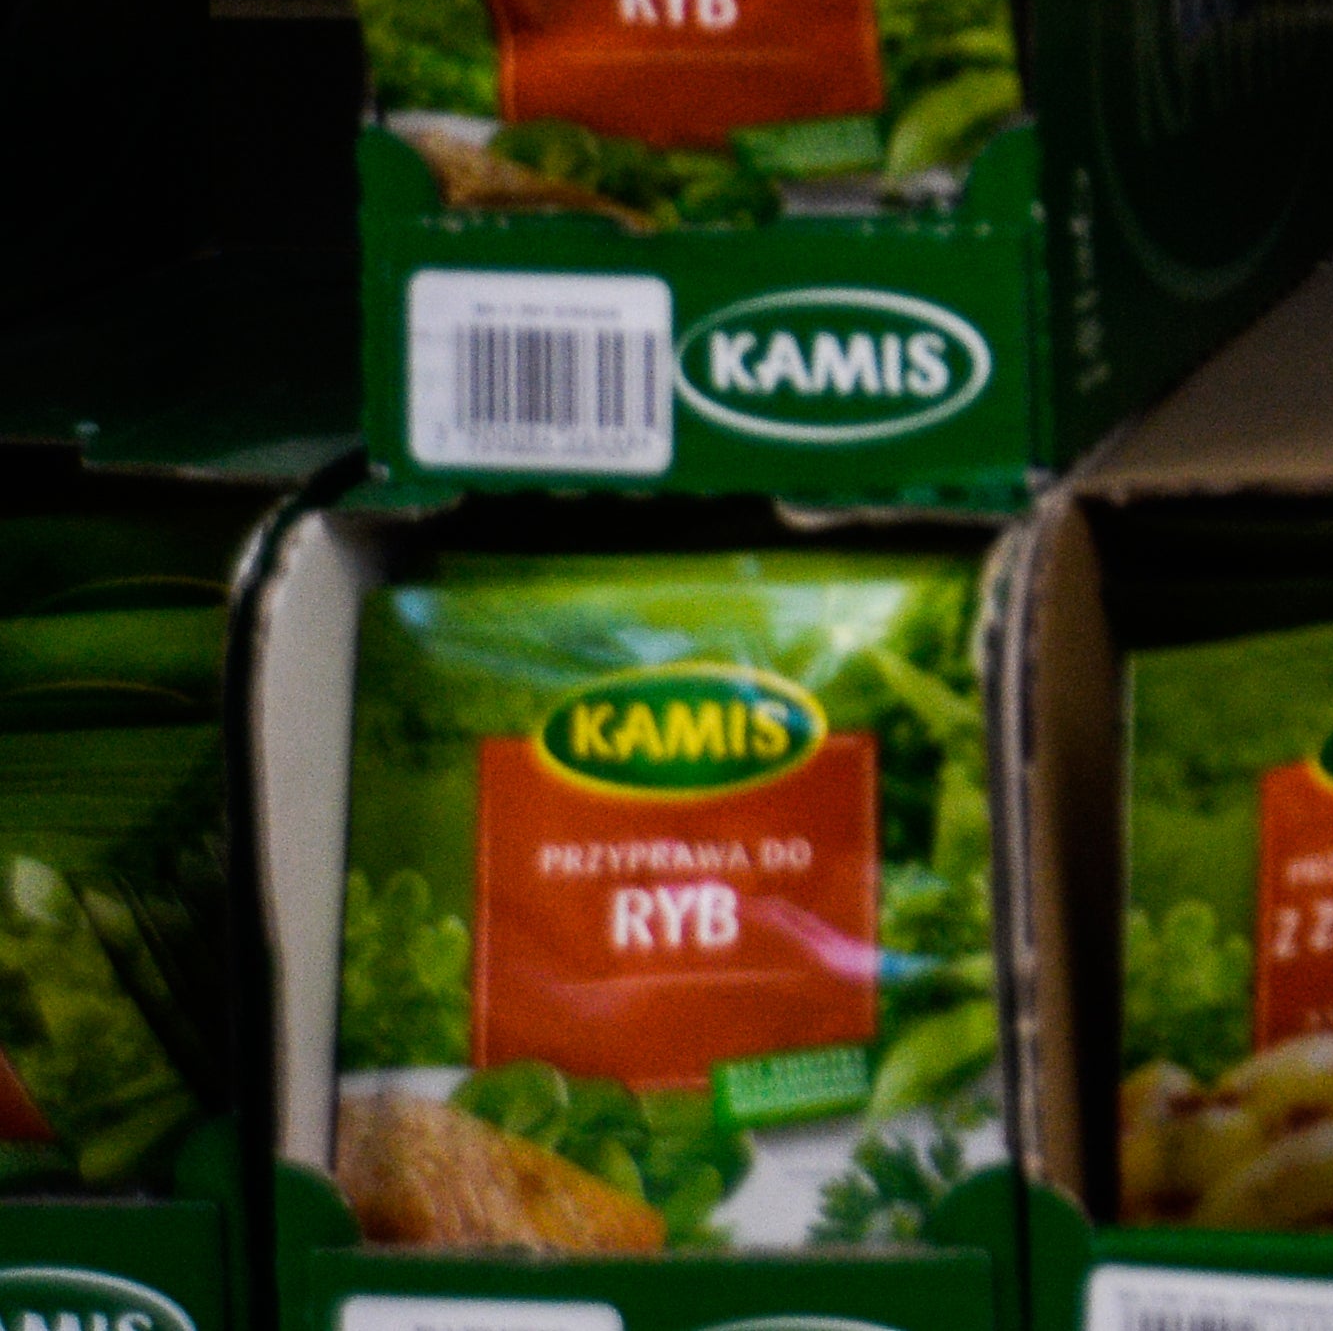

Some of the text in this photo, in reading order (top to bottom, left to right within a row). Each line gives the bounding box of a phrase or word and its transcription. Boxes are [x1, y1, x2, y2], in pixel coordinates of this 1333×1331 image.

[709, 329, 951, 399] KAMIS
[571, 700, 792, 761] KAMIS
[538, 835, 813, 877] PRZYPRAWA DO
[612, 880, 740, 951] RYB
[1272, 906, 1302, 960] Z
